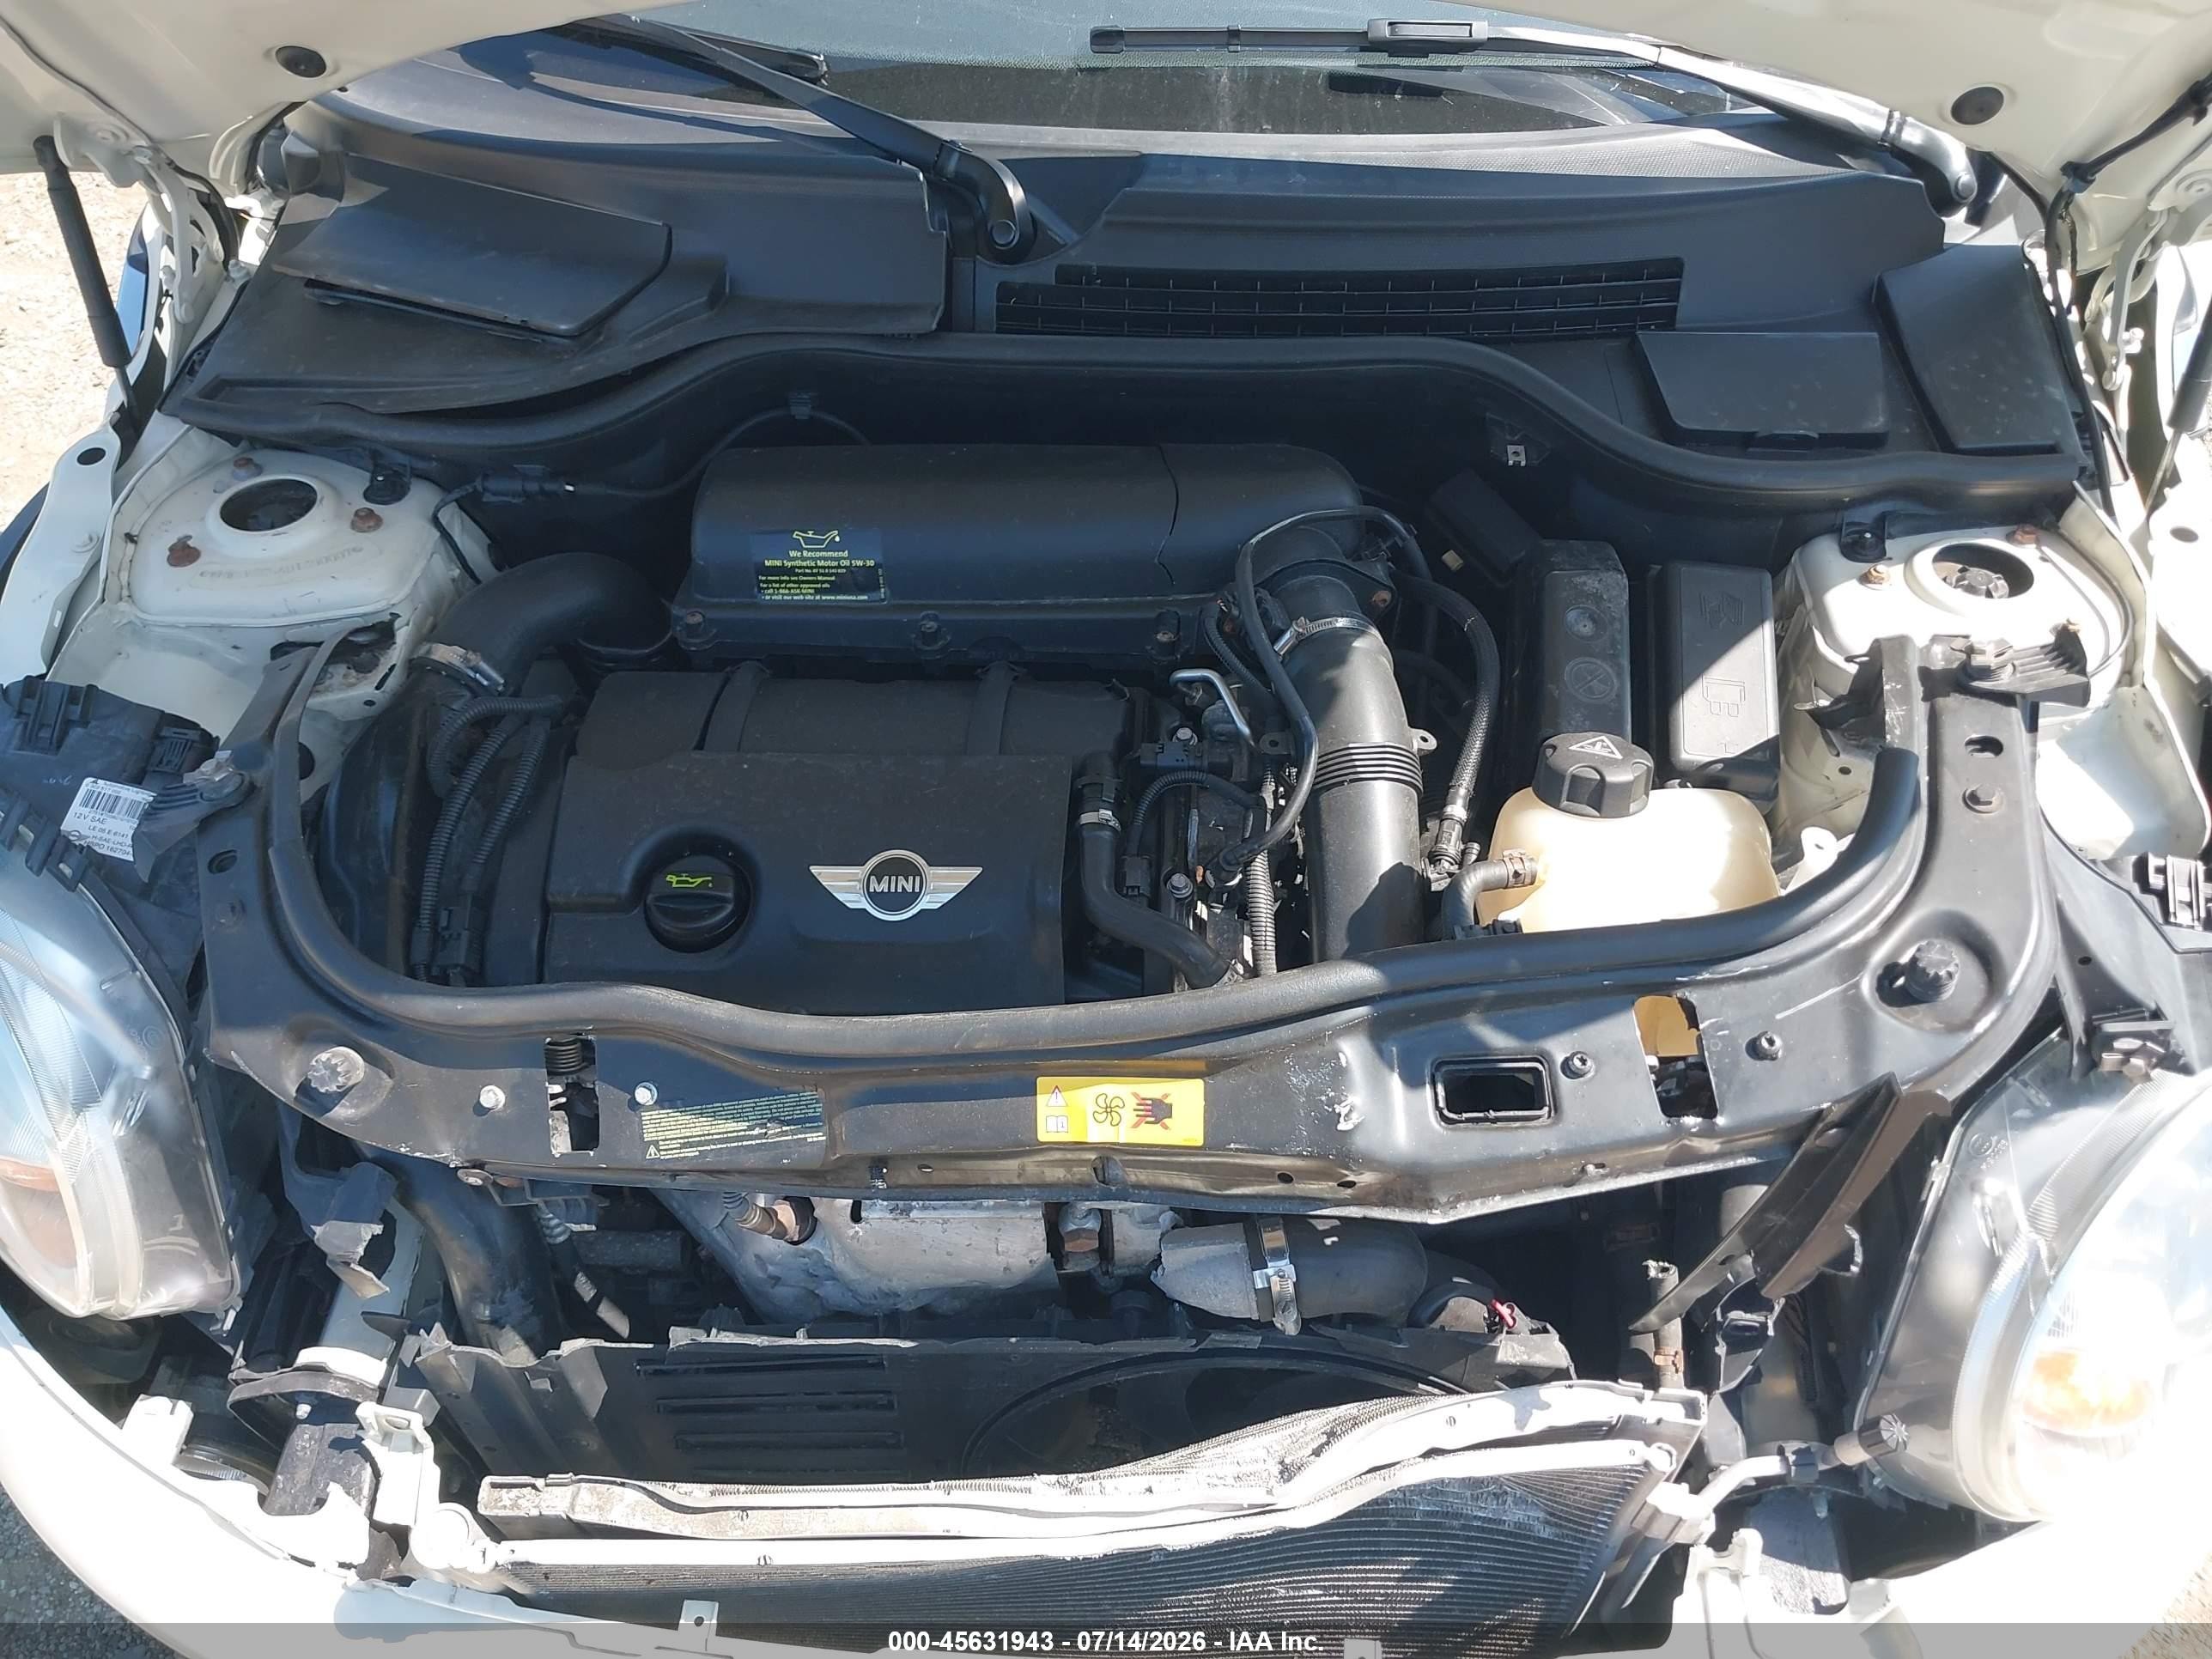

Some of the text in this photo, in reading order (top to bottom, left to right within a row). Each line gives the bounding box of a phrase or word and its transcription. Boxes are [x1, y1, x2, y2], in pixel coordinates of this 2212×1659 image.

[789, 550, 848, 558] We Recommend
[783, 559, 816, 568] Synthetic
[89, 815, 108, 825] SAE
[869, 875, 921, 893] MINI
